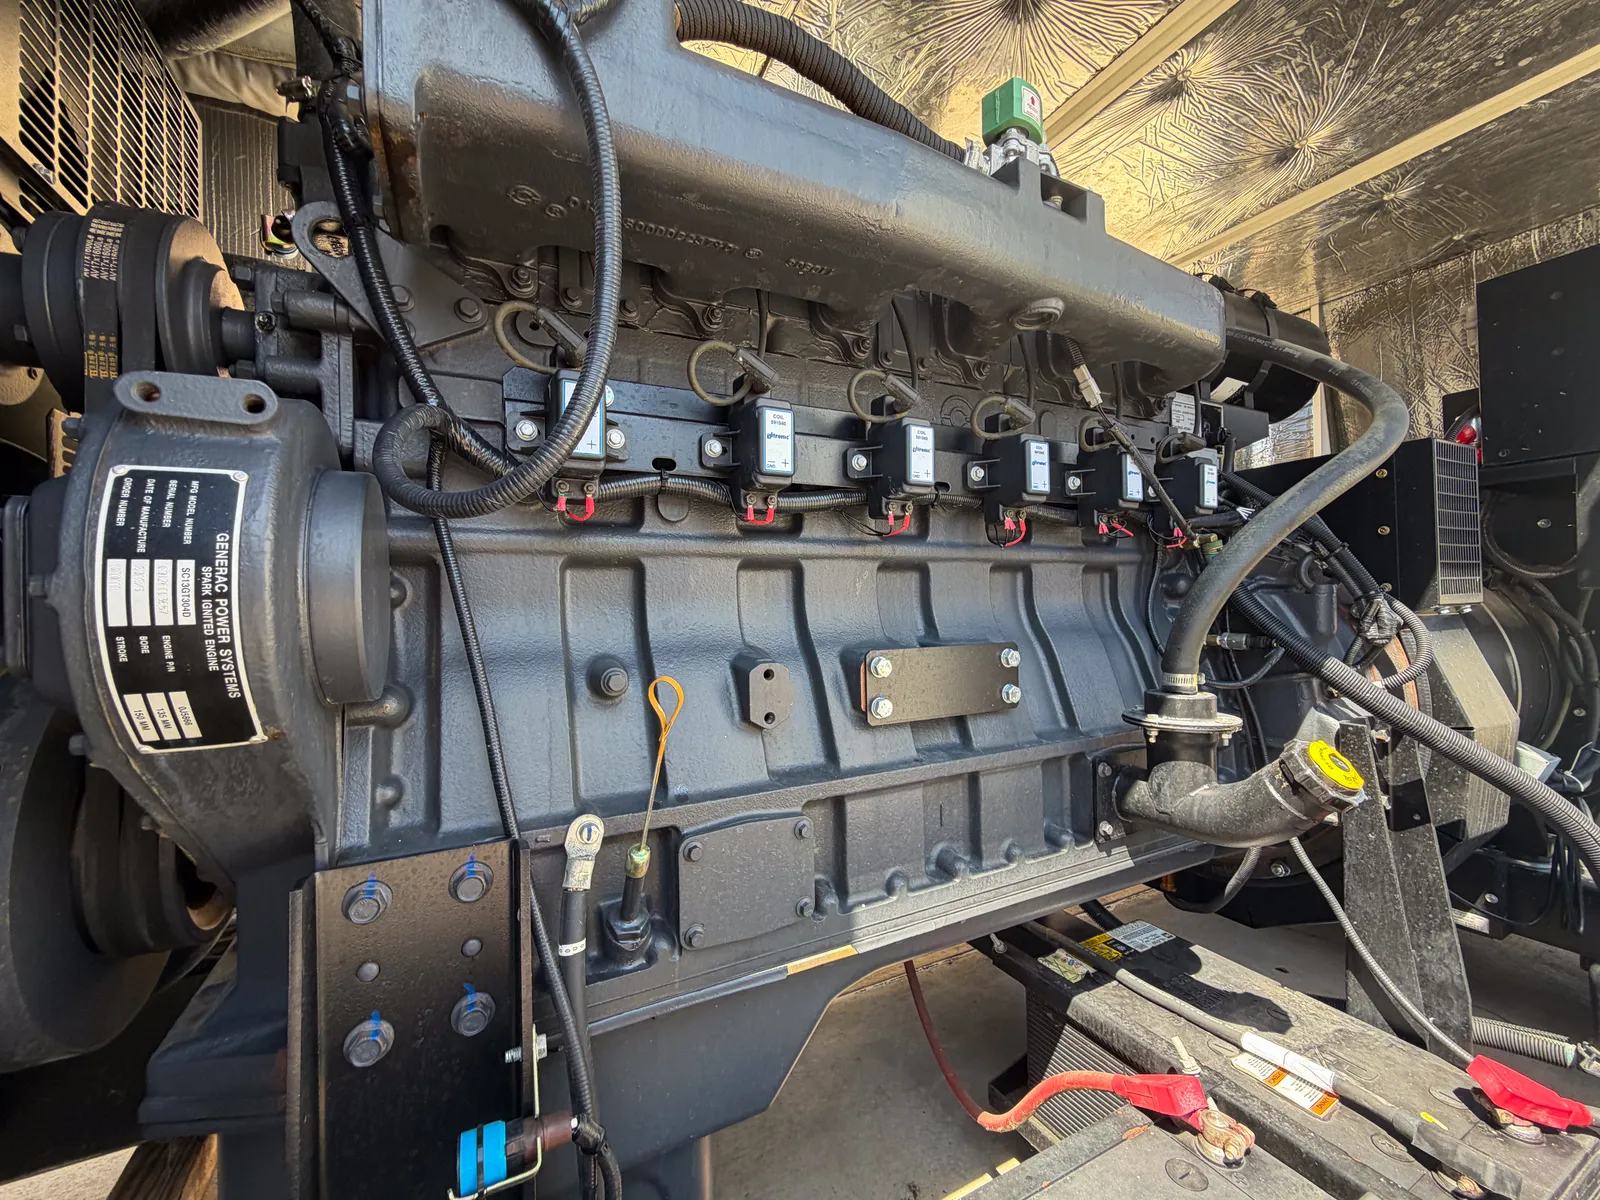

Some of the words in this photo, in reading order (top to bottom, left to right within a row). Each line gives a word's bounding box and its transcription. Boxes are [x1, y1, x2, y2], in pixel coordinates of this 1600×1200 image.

[121, 478, 133, 498] ORDER
[145, 478, 156, 494] DATE
[167, 480, 178, 500] SERIAL
[190, 480, 200, 493] MFG
[116, 500, 129, 526] NUMBER
[143, 496, 152, 504] OF
[187, 496, 198, 516] MODEL
[162, 502, 174, 528] NUMBER
[136, 506, 150, 553] MANUFACTURE
[183, 518, 194, 545] NUMBER
[214, 533, 229, 593] GENERAC
[181, 567, 191, 618] SC13GT304D
[200, 566, 212, 596] SPARK
[201, 599, 214, 635] IGNITED
[216, 599, 231, 644] POWER
[116, 636, 128, 663] STROKE
[139, 636, 150, 654] BORE
[162, 635, 173, 660] ENGINE
[205, 639, 219, 671] ENGINE
[166, 662, 175, 673] P/N
[219, 649, 241, 699] SYSTEMS
[140, 721, 150, 732] MM
[156, 708, 166, 718] 135
[162, 720, 172, 730] MM
